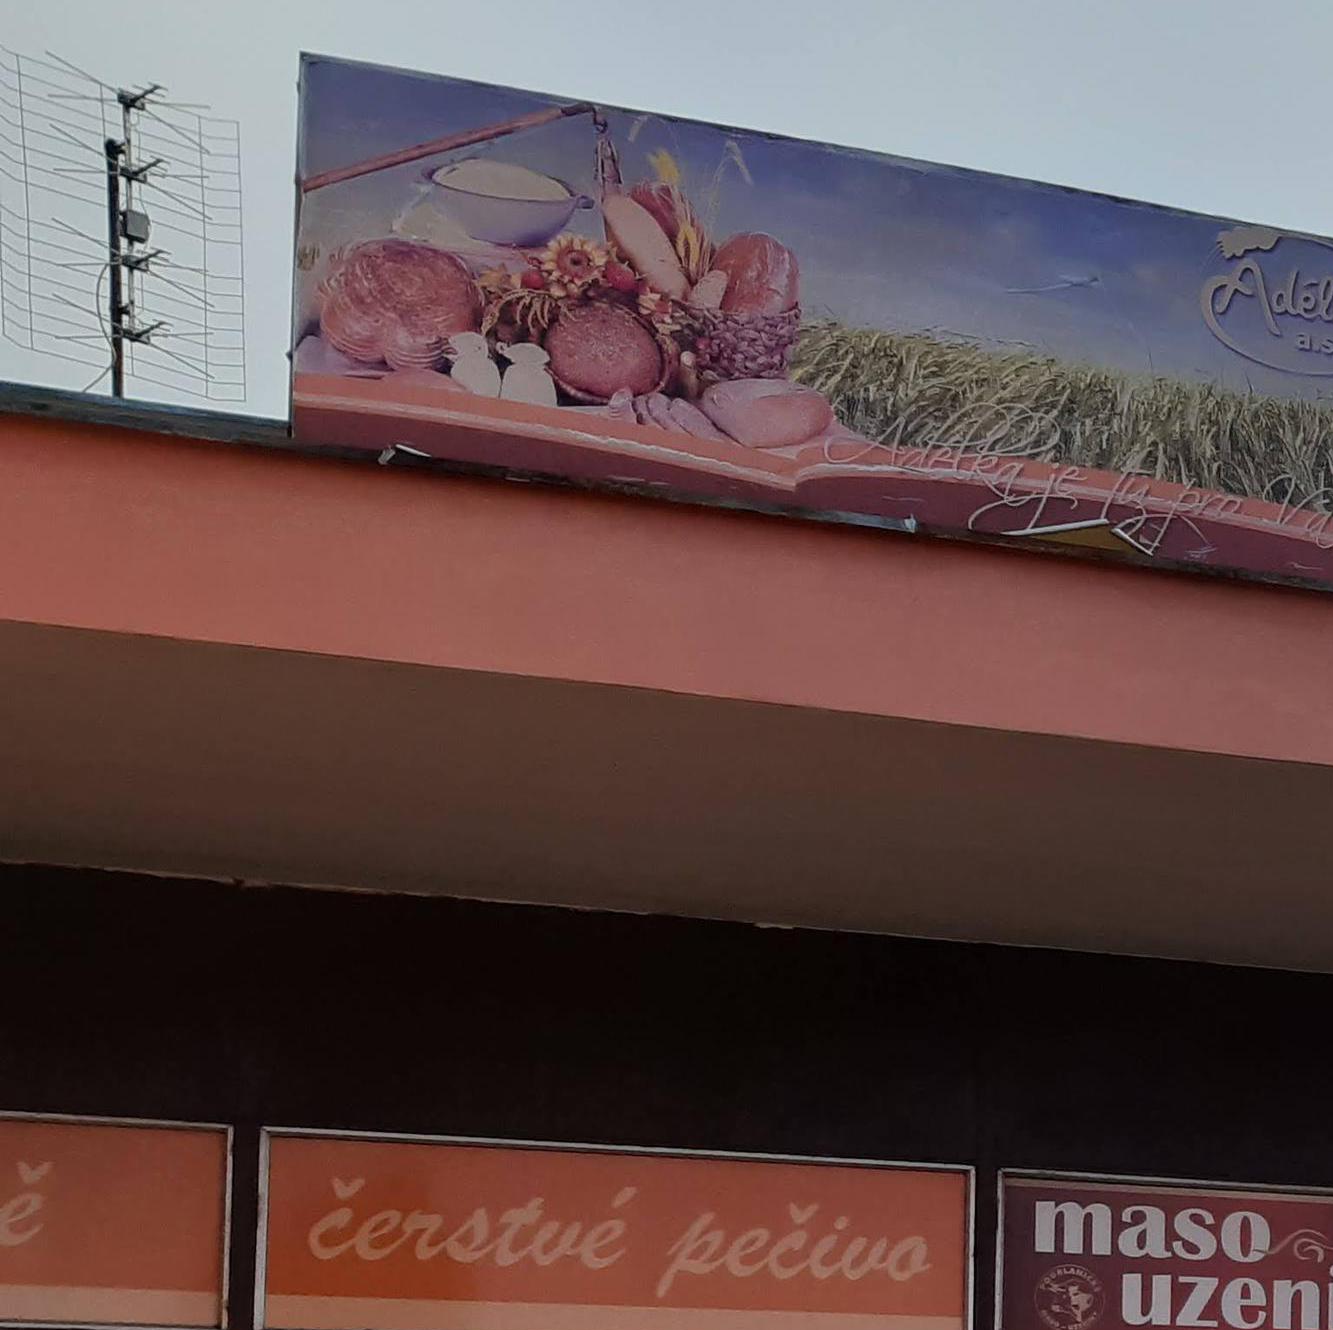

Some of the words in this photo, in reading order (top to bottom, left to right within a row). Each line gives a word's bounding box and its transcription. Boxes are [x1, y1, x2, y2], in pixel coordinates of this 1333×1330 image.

[307, 1177, 637, 1269] čerstvé
[656, 1202, 931, 1299] pečivo
[1034, 1200, 1271, 1263] maso
